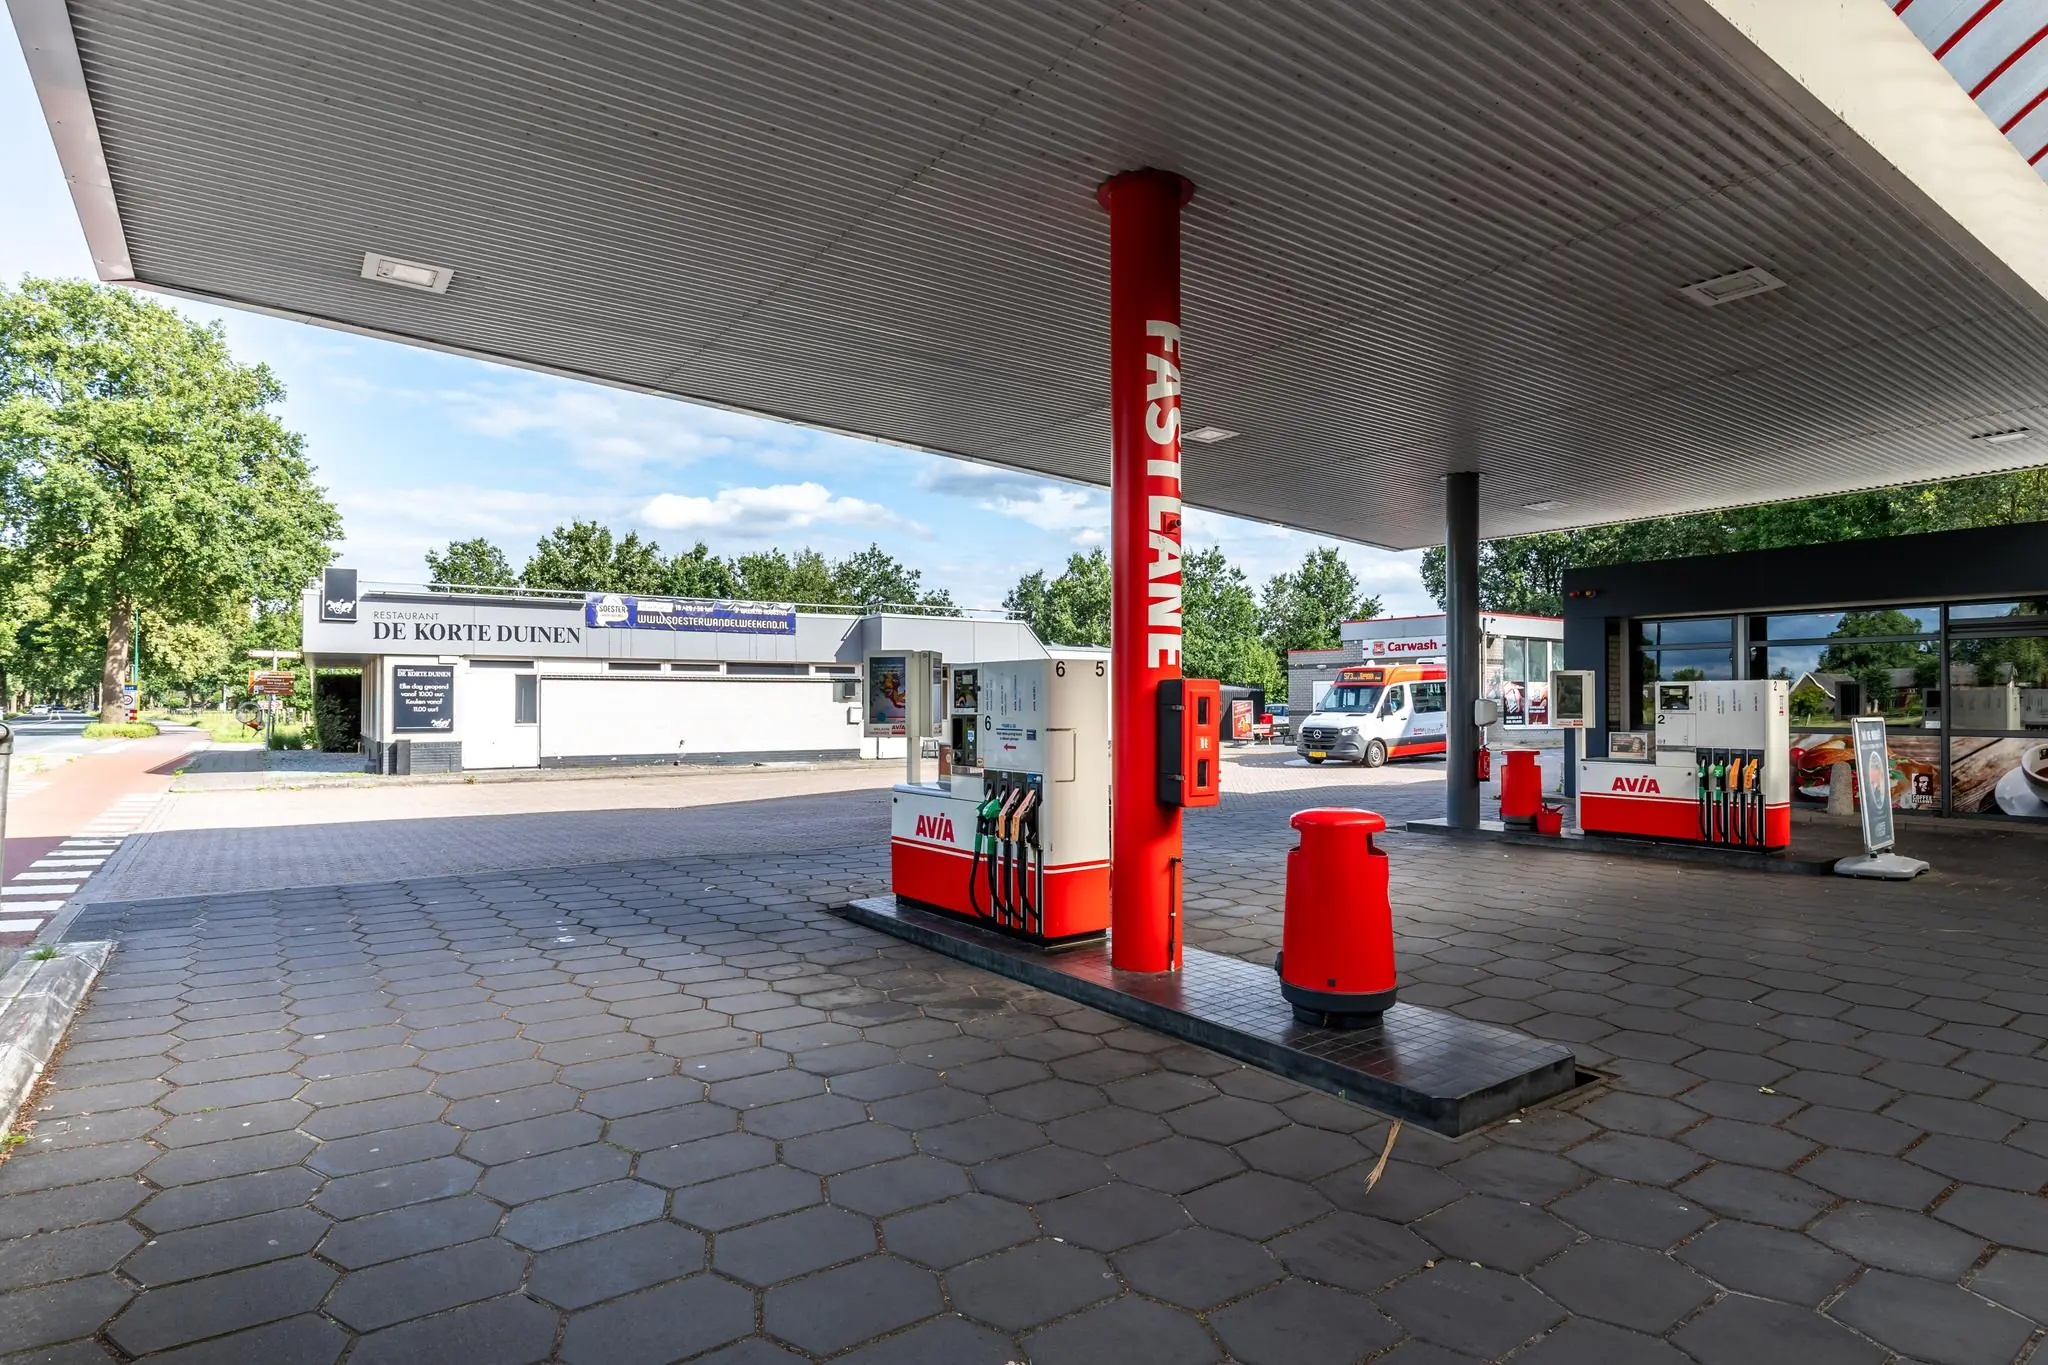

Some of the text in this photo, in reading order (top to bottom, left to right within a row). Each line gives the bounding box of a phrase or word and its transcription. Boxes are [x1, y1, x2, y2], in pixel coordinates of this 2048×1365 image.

[373, 611, 439, 620] RESTAURANT
[599, 605, 626, 613] SOESTER
[637, 614, 789, 630] WWW.SOESTERWANDELWEEKEND.NL
[373, 622, 581, 644] DE KORTE DUINEN
[1387, 639, 1437, 652] Carwash
[1056, 661, 1105, 677] 6 5
[1773, 680, 1777, 691] 2
[984, 715, 991, 731] 6
[1657, 714, 1665, 724] 2
[1611, 775, 1660, 793] AVIA
[916, 812, 955, 842] AVIA
